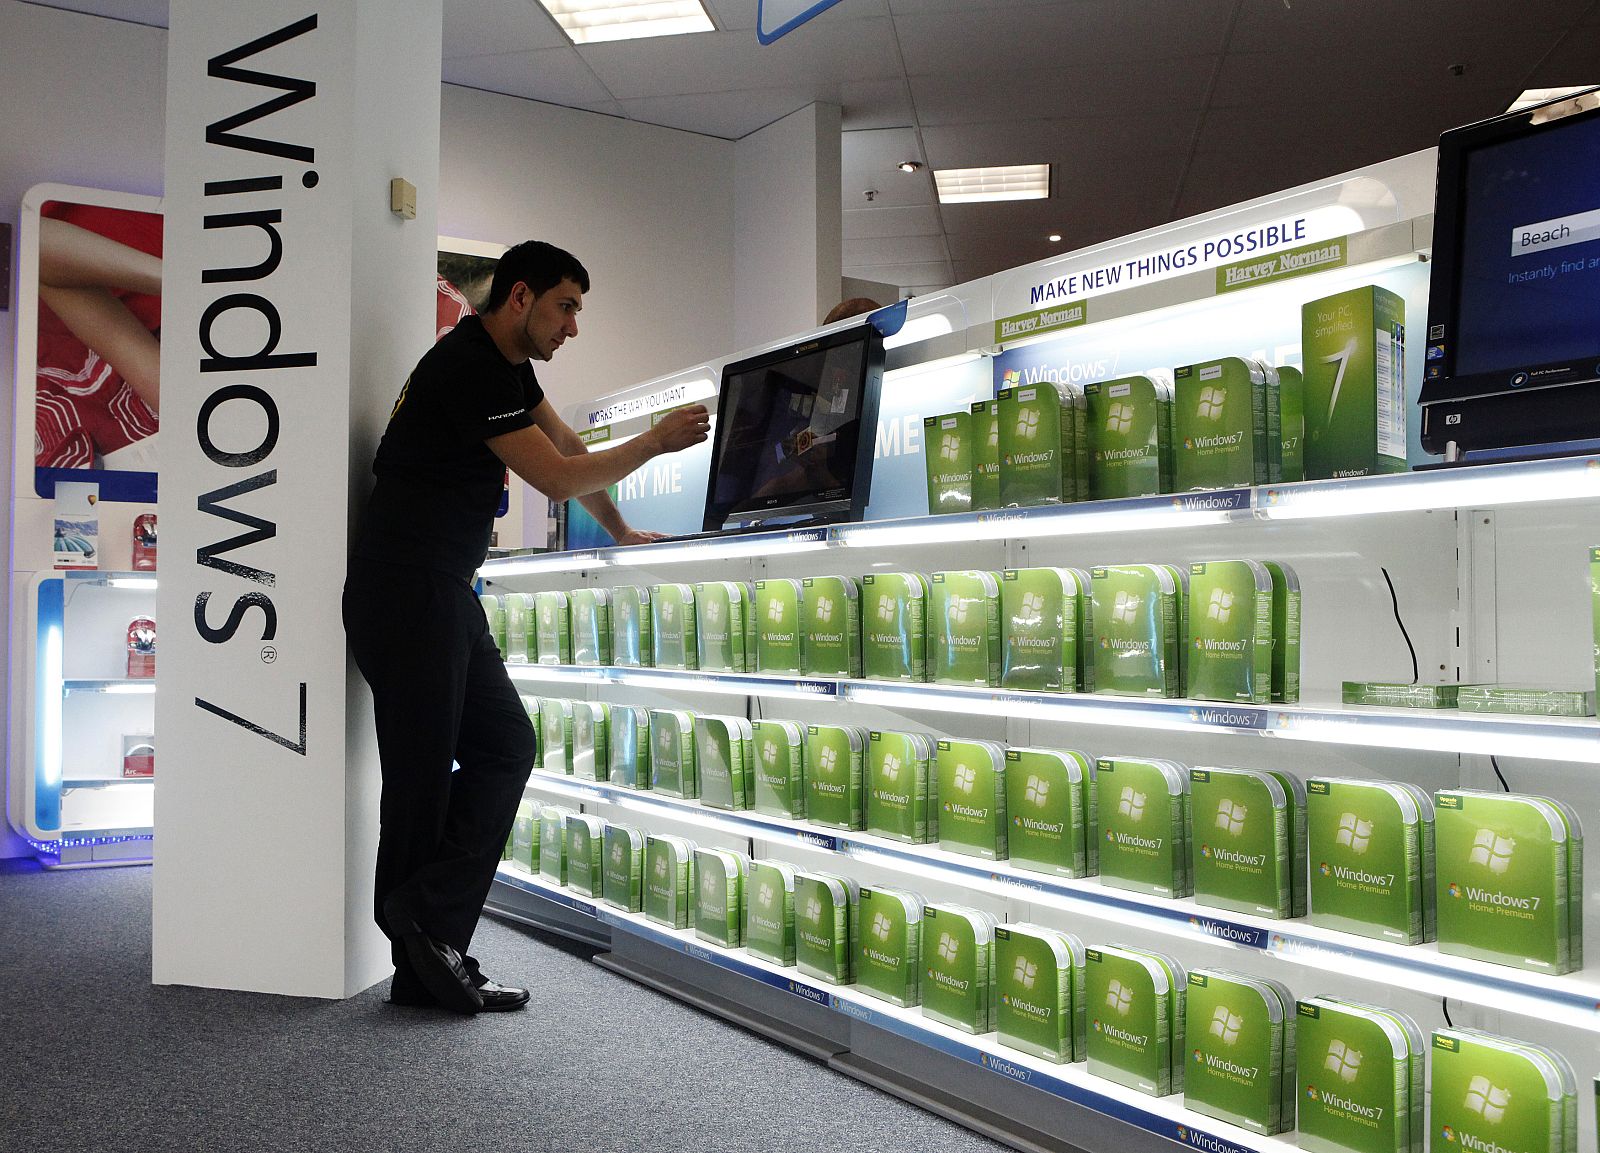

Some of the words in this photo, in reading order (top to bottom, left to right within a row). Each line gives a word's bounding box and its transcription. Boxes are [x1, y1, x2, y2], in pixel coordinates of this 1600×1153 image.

[1521, 224, 1570, 247] Beach
[1030, 276, 1077, 304] MAKE
[1083, 264, 1121, 291] NEW
[1126, 245, 1198, 280] THINGS
[1204, 218, 1306, 261] POSSIBLE
[1225, 260, 1277, 284] Harvey
[1279, 242, 1341, 271] Norman
[1508, 264, 1558, 284] Instantly
[1561, 258, 1585, 273] find
[1001, 318, 1037, 335] Harvey
[1039, 306, 1082, 326] Norman
[1317, 310, 1336, 324] Your
[1024, 360, 1106, 385] Windows
[1111, 351, 1120, 375] 7
[588, 407, 613, 425] WORKS
[613, 403, 627, 418] THE
[629, 399, 644, 413] WAY
[644, 395, 660, 408] YOU
[662, 387, 686, 404] WANT
[1194, 434, 1236, 449] Windows
[1237, 431, 1243, 443] 7
[1291, 437, 1298, 449] 7
[1014, 452, 1048, 465] Windows
[1049, 450, 1054, 460] 7
[1104, 447, 1144, 461] Windows
[1144, 445, 1150, 456] 7
[1197, 448, 1214, 456] Home
[1214, 445, 1240, 455] Premium
[653, 463, 682, 497] ME
[1339, 468, 1365, 478] Windows
[1364, 467, 1369, 476] 7
[1185, 495, 1233, 510] Windows
[1235, 494, 1241, 507] 7
[793, 532, 819, 541] Windows
[819, 531, 823, 539] 7
[768, 633, 790, 641] Windows
[815, 633, 838, 642] Windows
[1017, 636, 1051, 647] Windows
[1051, 638, 1056, 647] 7
[1111, 638, 1149, 650] Windows
[1204, 639, 1240, 651] Windows
[1241, 639, 1247, 650] 7
[1220, 652, 1243, 660] Premium
[801, 683, 826, 693] Windows
[827, 684, 831, 693] 7
[195, 682, 307, 757] 7
[1201, 710, 1250, 725] Windows
[1252, 713, 1259, 725] 7
[818, 781, 842, 793] Windows
[842, 784, 846, 793] 7
[879, 790, 905, 804] Windows
[905, 795, 910, 805] 7
[952, 803, 983, 817] Windows
[983, 808, 988, 817] 7
[1023, 818, 1058, 833] Windows
[1058, 823, 1064, 833] 7
[803, 833, 829, 848] Windows
[829, 838, 833, 848] 7
[1116, 832, 1156, 848] Windows
[1156, 838, 1162, 849] 7
[1118, 845, 1134, 853] Home
[1135, 847, 1159, 857] Premium
[1214, 847, 1258, 866] Windows
[1258, 855, 1266, 866] 7
[1216, 860, 1233, 870] Home
[1235, 864, 1262, 875] Premium
[1334, 865, 1386, 886] Windows
[1386, 874, 1395, 887] 7
[1336, 880, 1357, 890] Home
[1358, 883, 1390, 896] Premium
[1466, 886, 1529, 910] Windows
[1530, 897, 1541, 911] 7
[1469, 902, 1494, 915] Home
[1496, 907, 1534, 920] Premium
[804, 932, 827, 946] Windows
[827, 938, 831, 947] 7
[1202, 920, 1251, 943] Windows
[1253, 932, 1260, 944] 7
[689, 945, 710, 960] Windows
[869, 948, 896, 965] Windows
[896, 957, 900, 966] 7
[935, 972, 964, 990] Windows
[964, 980, 969, 991] 7
[795, 983, 820, 1001] Windows
[820, 993, 825, 1002] 7
[840, 1000, 868, 1019] Windows
[868, 1011, 872, 1021] 7
[1011, 997, 1046, 1016] Windows
[1046, 1007, 1051, 1018] 7
[1103, 1023, 1142, 1044] Windows
[1142, 1035, 1148, 1047] 7
[1105, 1036, 1121, 1046] Home
[1121, 1040, 1145, 1054] Premium
[989, 1056, 1026, 1080] Windows
[1026, 1071, 1032, 1081] 7
[1205, 1053, 1251, 1077] Windows
[1251, 1067, 1259, 1079] 7
[1207, 1067, 1225, 1079] Home
[1226, 1073, 1254, 1087] Premium
[1321, 1090, 1374, 1118] Windows
[1374, 1107, 1383, 1120] 7
[1323, 1104, 1345, 1118] Home
[1346, 1113, 1378, 1129] Premium
[1459, 1131, 1530, 1153] Windo
